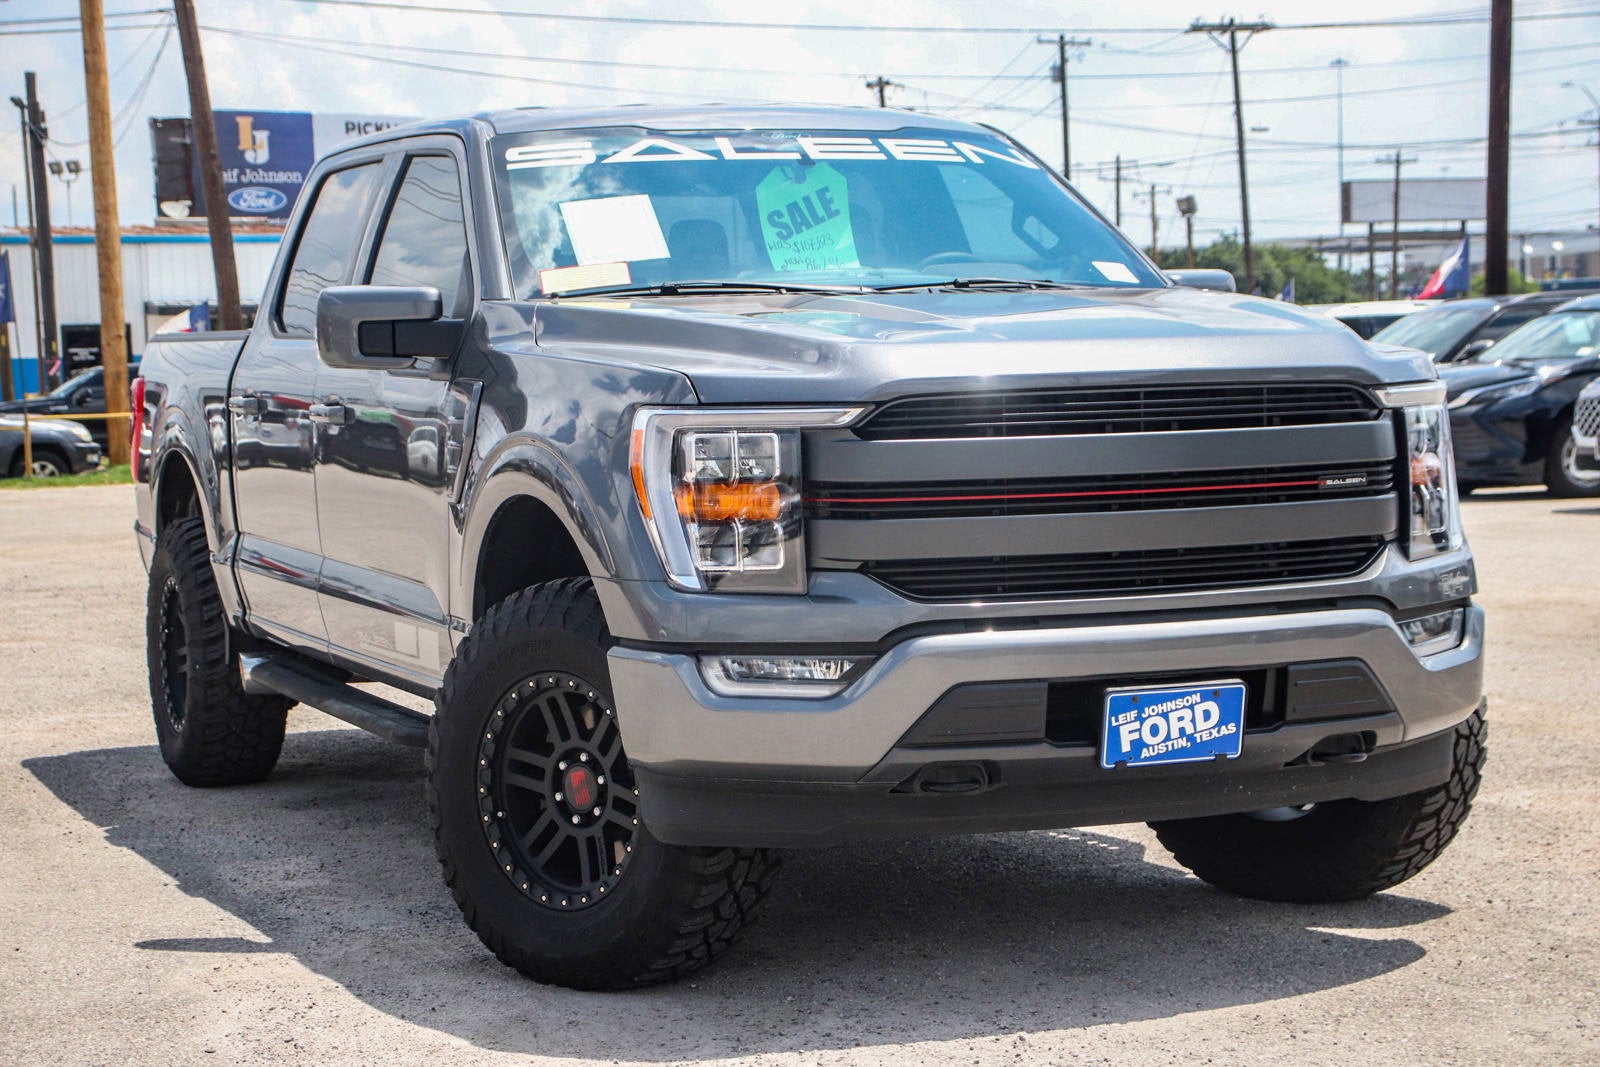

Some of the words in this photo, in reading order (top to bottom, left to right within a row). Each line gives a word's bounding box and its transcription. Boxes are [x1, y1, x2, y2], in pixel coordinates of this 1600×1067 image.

[505, 137, 1042, 170] SALEEN
[241, 168, 302, 184] Johnson
[767, 186, 840, 240] SALE
[1326, 477, 1366, 485] SALEEN
[1111, 710, 1138, 727] LEIF
[1142, 693, 1201, 718] JOHNSON
[1119, 701, 1220, 753] FORD
[1140, 737, 1191, 759] AUSTIN,
[1194, 723, 1237, 744] TEXAS
